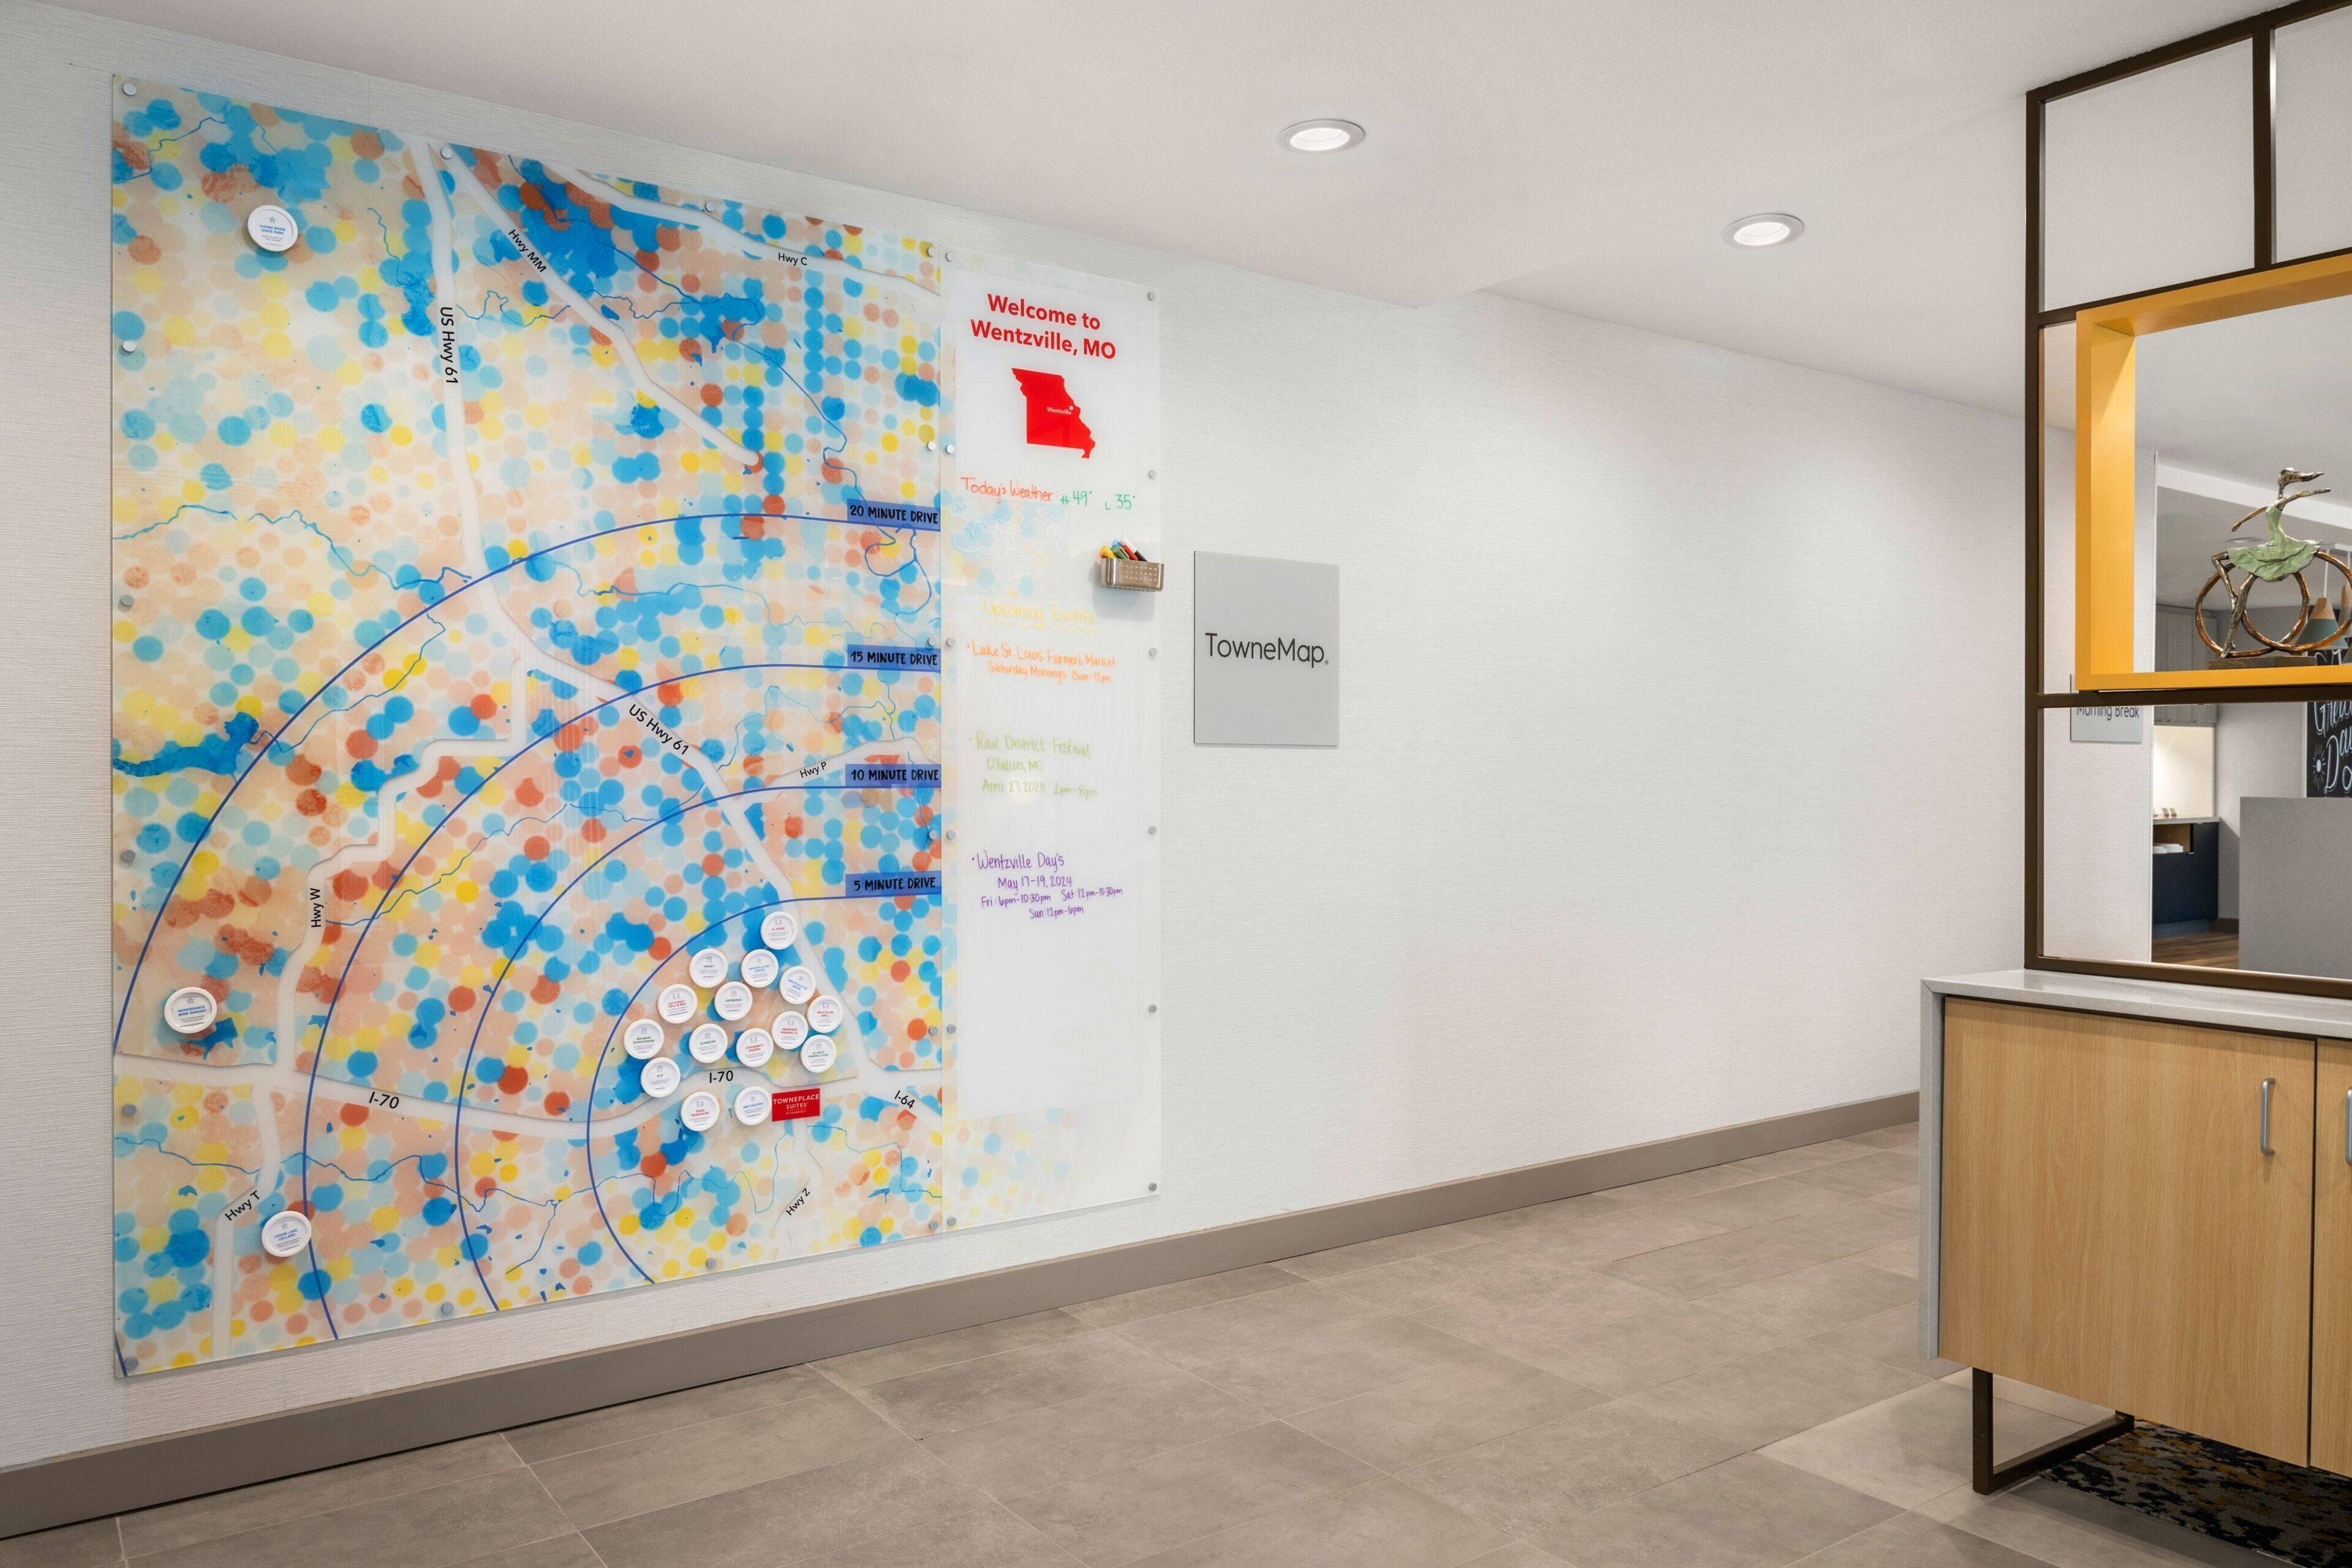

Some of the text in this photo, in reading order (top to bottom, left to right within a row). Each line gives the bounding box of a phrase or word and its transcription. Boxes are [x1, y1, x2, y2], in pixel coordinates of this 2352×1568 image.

[508, 229, 547, 273] Hwy MM
[778, 252, 807, 266] Hwy C
[987, 293, 1101, 330] Welcome to
[440, 307, 458, 383] US Hwy 61
[970, 319, 1116, 360] Wentzville, MO
[1047, 406, 1072, 415] Wentzville
[960, 477, 1006, 504] Today's
[850, 505, 938, 524] 20 MINUTE DRIVE
[983, 598, 1098, 630] Upcoming Events
[850, 650, 937, 666] 15 MINUTE DRIVE
[972, 640, 1000, 657] Lake
[1085, 654, 1117, 668] Market
[988, 660, 1027, 680] Saturday
[1030, 665, 1066, 685] Mornings
[2076, 706, 2139, 721] Morning Break
[630, 704, 689, 755] US Hwy 61
[1005, 734, 1046, 752] District
[1052, 737, 1091, 759] Festival
[800, 761, 827, 778] Hwy P
[851, 769, 938, 781] 10 MINUTE DRIVE
[982, 778, 1005, 794] April
[1023, 780, 1046, 793] 2024
[977, 850, 1065, 872] Wentzville Day's
[854, 877, 935, 891] 5 MINUTE DRIVE
[998, 877, 1018, 895] May
[1050, 876, 1073, 888] 2024
[310, 888, 324, 927] Hwy W
[709, 1070, 733, 1083] I-70
[369, 1091, 399, 1109] I-70
[773, 1094, 820, 1104] TOWNEPLACE
[894, 1090, 915, 1109] I-64
[225, 1190, 260, 1221] Hwy T
[786, 1188, 810, 1215] Hwy Z
